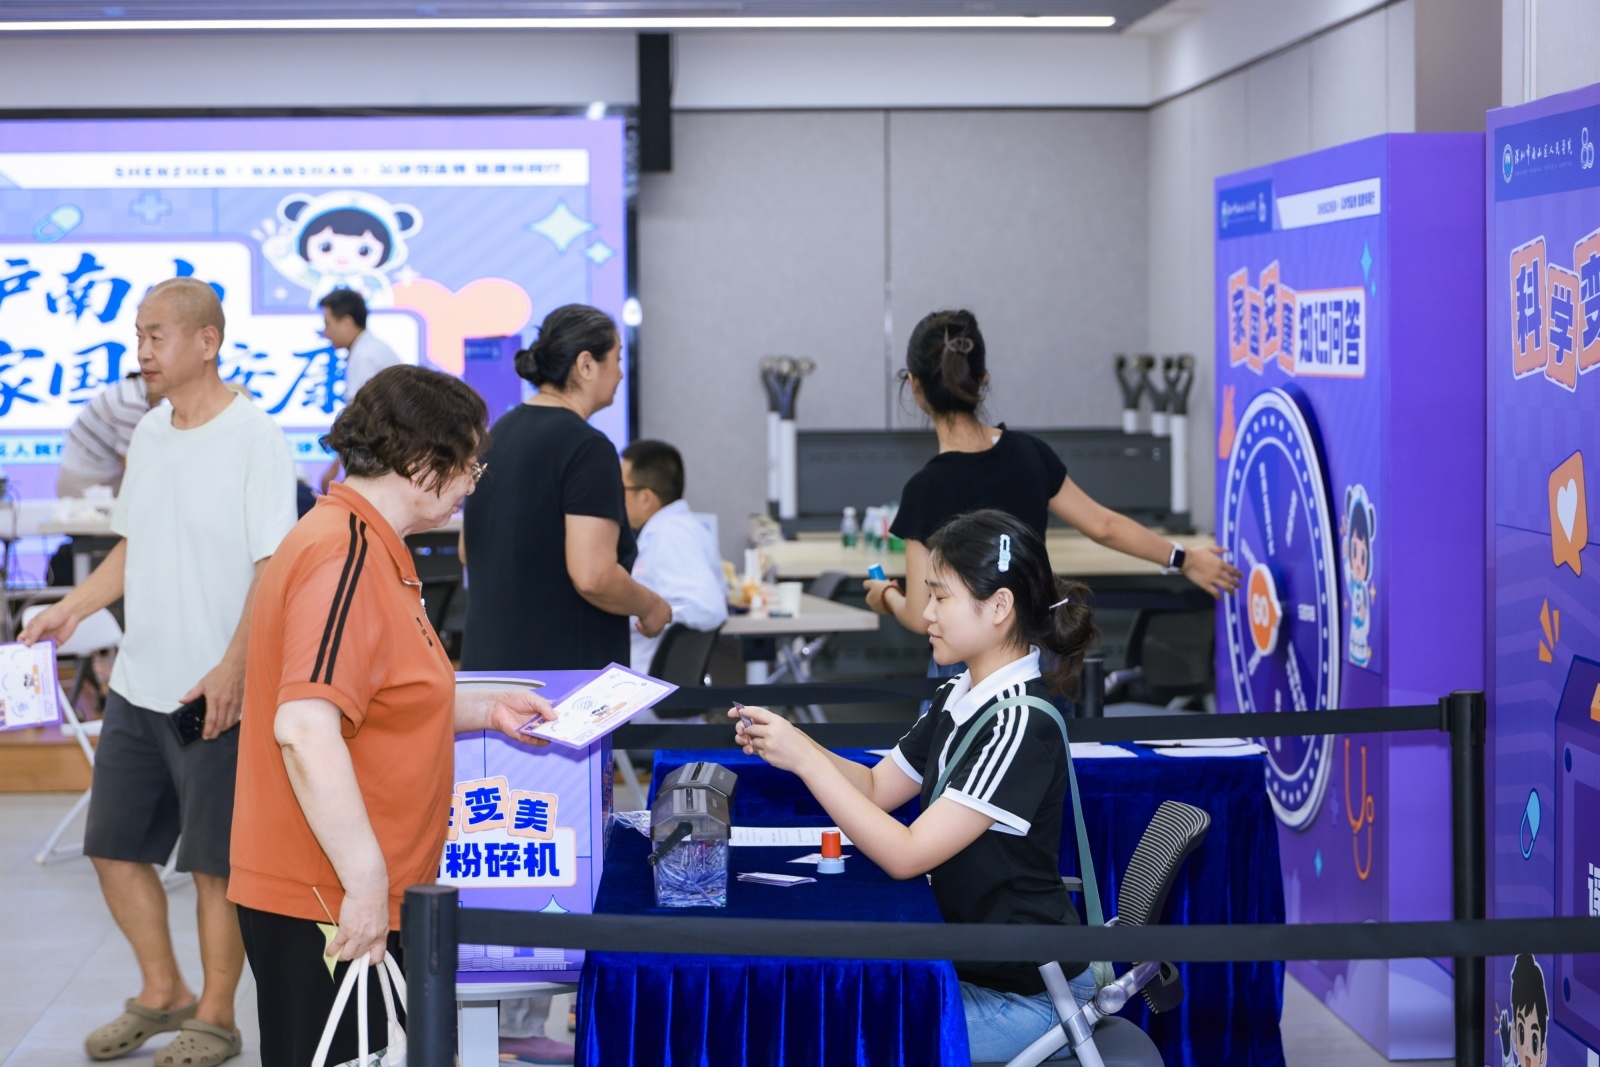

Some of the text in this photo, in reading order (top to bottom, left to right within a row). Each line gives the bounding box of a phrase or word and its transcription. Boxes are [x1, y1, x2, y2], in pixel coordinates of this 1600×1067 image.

[1299, 299, 1361, 365] 知识问答
[447, 786, 550, 833] 变美
[436, 842, 560, 879] 粉碎机
